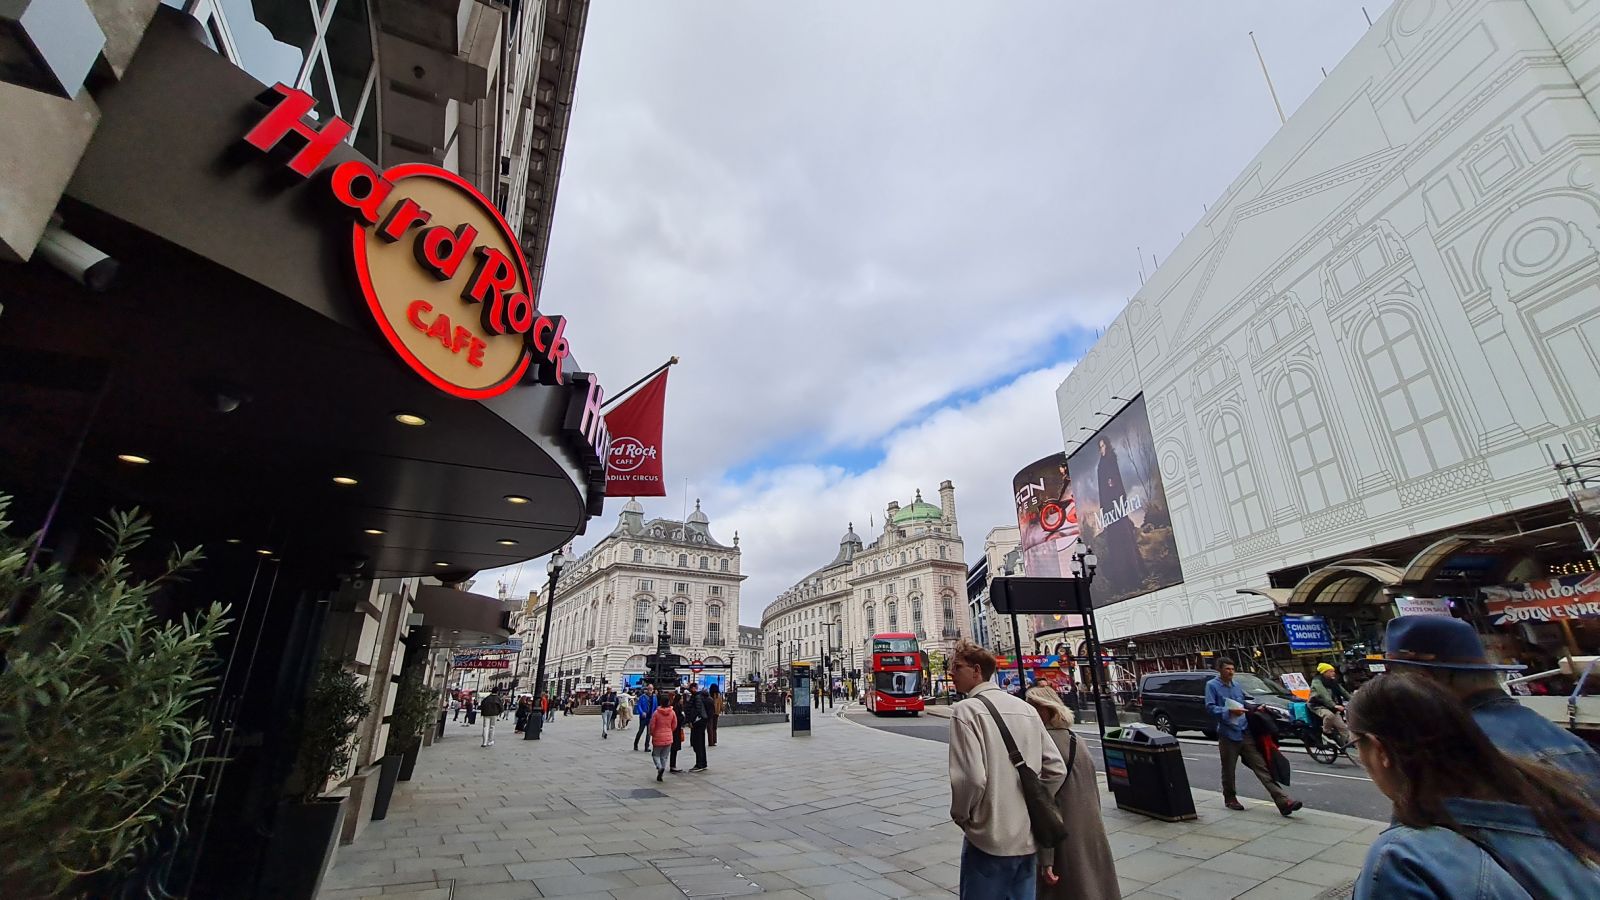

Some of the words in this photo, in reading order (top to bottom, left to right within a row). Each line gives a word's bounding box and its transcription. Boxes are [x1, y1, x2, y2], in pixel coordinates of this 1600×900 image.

[244, 81, 478, 280] Hard
[469, 246, 570, 386] Rock
[406, 299, 488, 368] CAFE
[625, 443, 657, 459] Rock
[632, 474, 659, 482] CIRCUS
[1094, 494, 1142, 531] MaxMara
[1296, 631, 1321, 639] MONEY
[486, 660, 507, 668] ZONE
